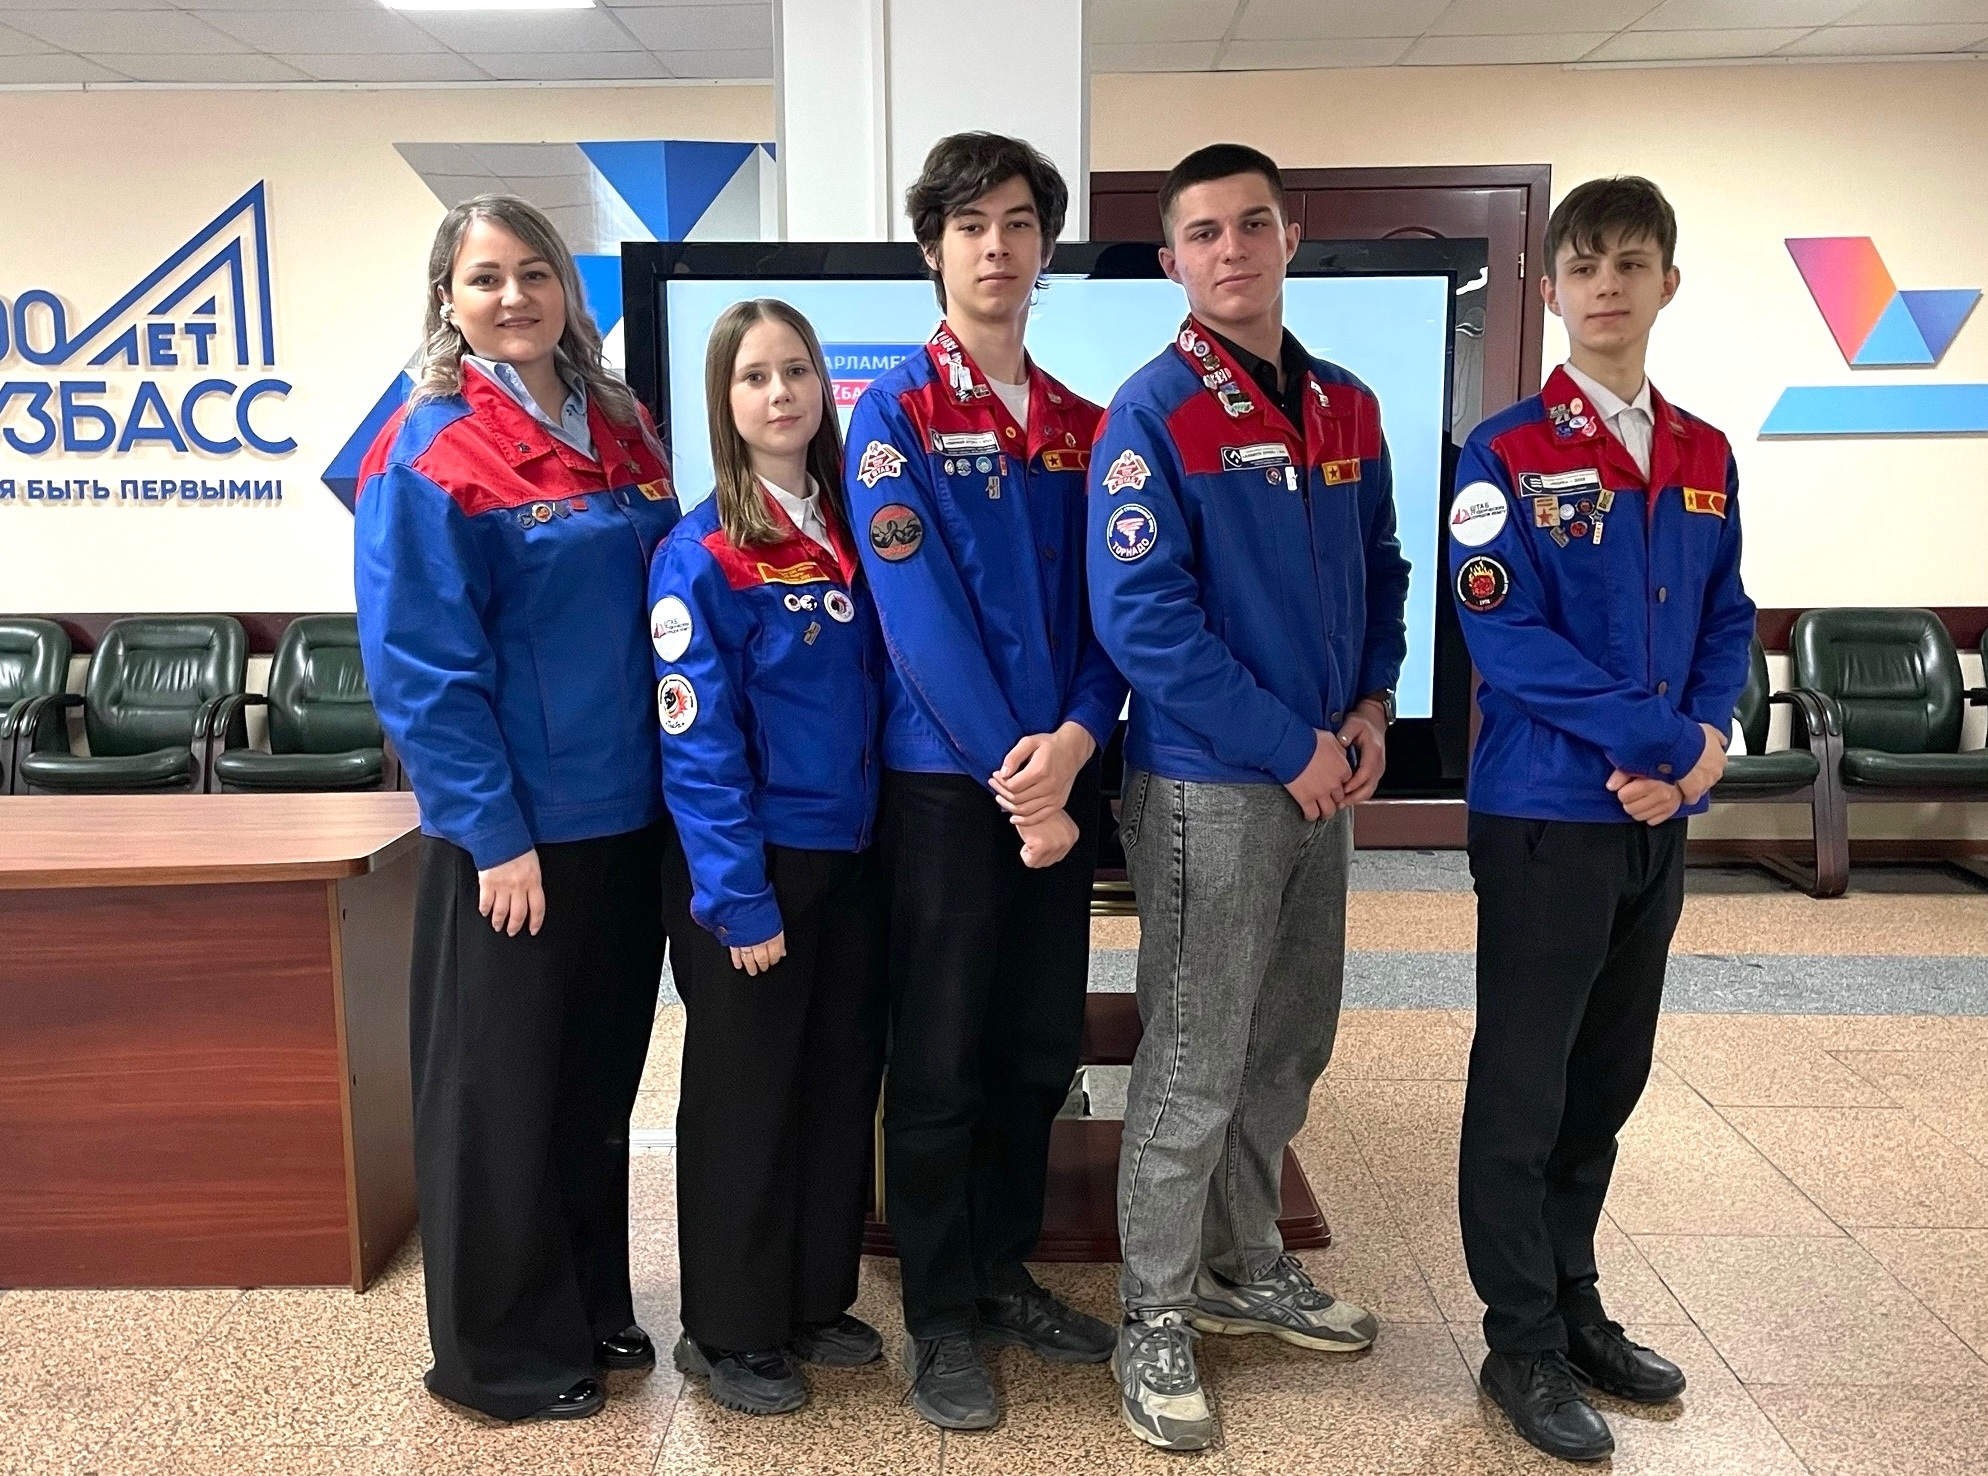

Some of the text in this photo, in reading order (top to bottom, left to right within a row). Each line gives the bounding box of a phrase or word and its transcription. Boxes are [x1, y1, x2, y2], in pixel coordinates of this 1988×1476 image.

[0, 289, 67, 365] 0
[825, 355, 906, 370] АРЛАМЕ
[0, 379, 298, 455] ЗБАСС
[28, 479, 111, 500] БЫТЬ
[120, 479, 283, 500] ПЕРВЫМИ!
[1112, 538, 1150, 557] ТОРНАДО
